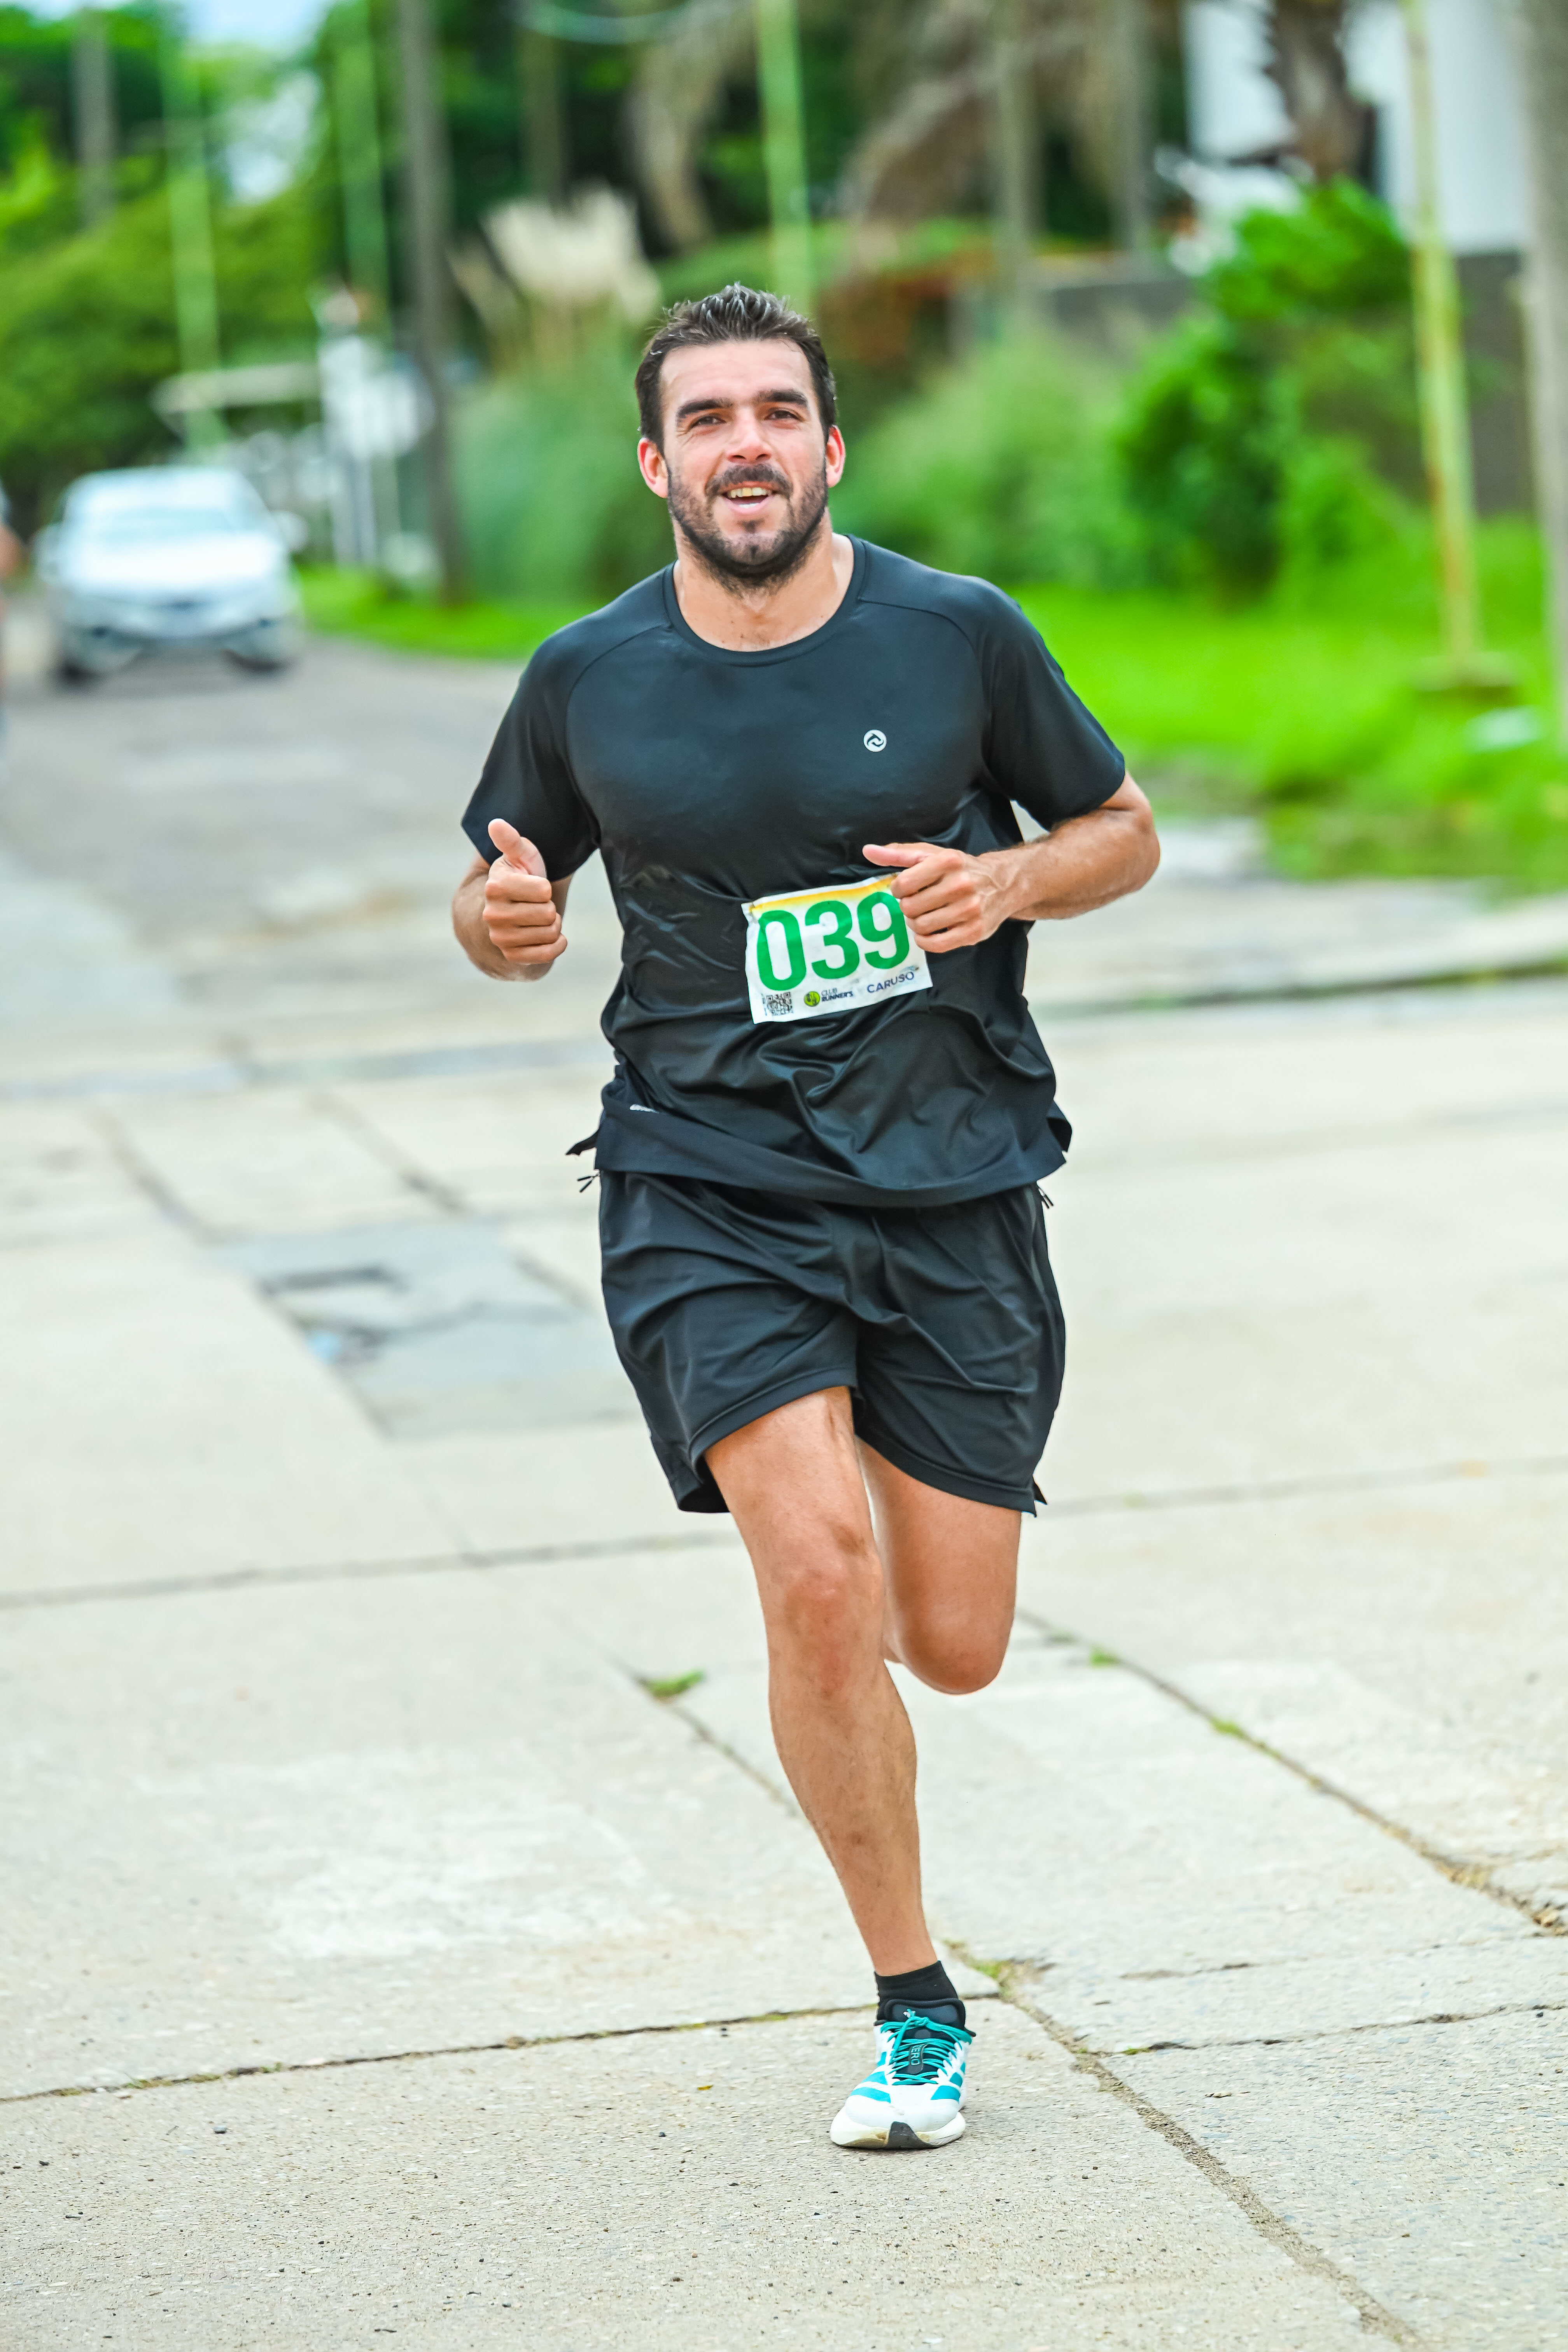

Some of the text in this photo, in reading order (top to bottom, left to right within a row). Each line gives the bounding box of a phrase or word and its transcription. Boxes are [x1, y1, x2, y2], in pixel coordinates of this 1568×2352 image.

[757, 892, 910, 991] 039
[821, 988, 837, 997] CLUB
[867, 971, 914, 993] CARUSO
